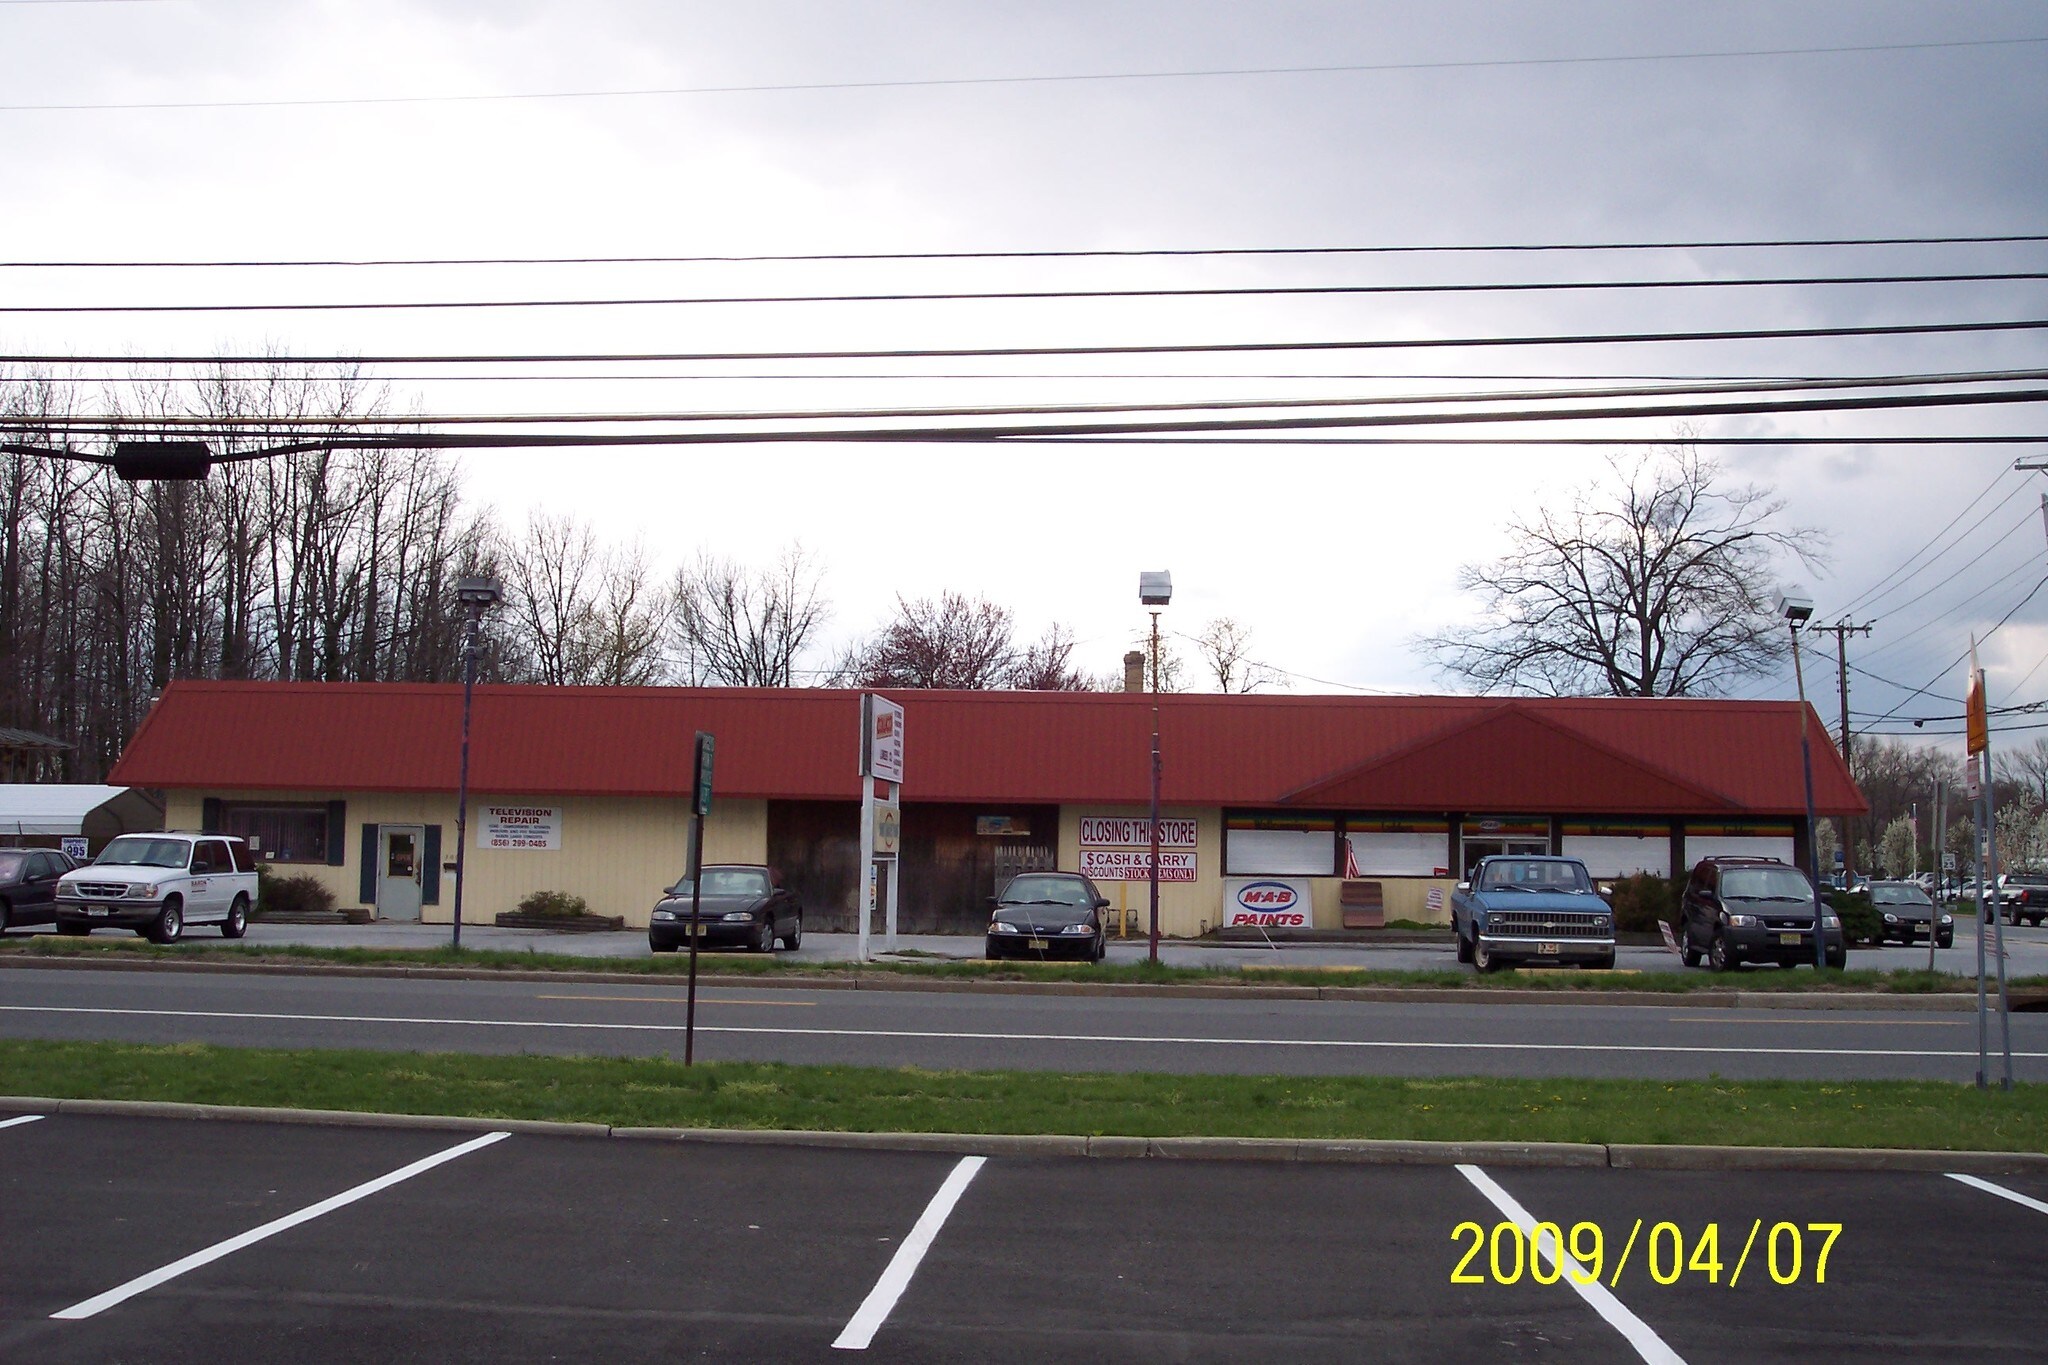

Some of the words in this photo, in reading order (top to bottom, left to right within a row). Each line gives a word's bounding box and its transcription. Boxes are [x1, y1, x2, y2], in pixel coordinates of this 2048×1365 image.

[489, 808, 552, 816] TELEVISION
[1083, 820, 1130, 842] CLOSING
[1133, 822, 1152, 843] THI
[1160, 822, 1195, 844] STORE
[1133, 854, 1142, 866] &
[1082, 866, 1124, 879] DISCOUNTS
[1125, 868, 1150, 879] STOCK
[1232, 913, 1305, 926] PAINTS
